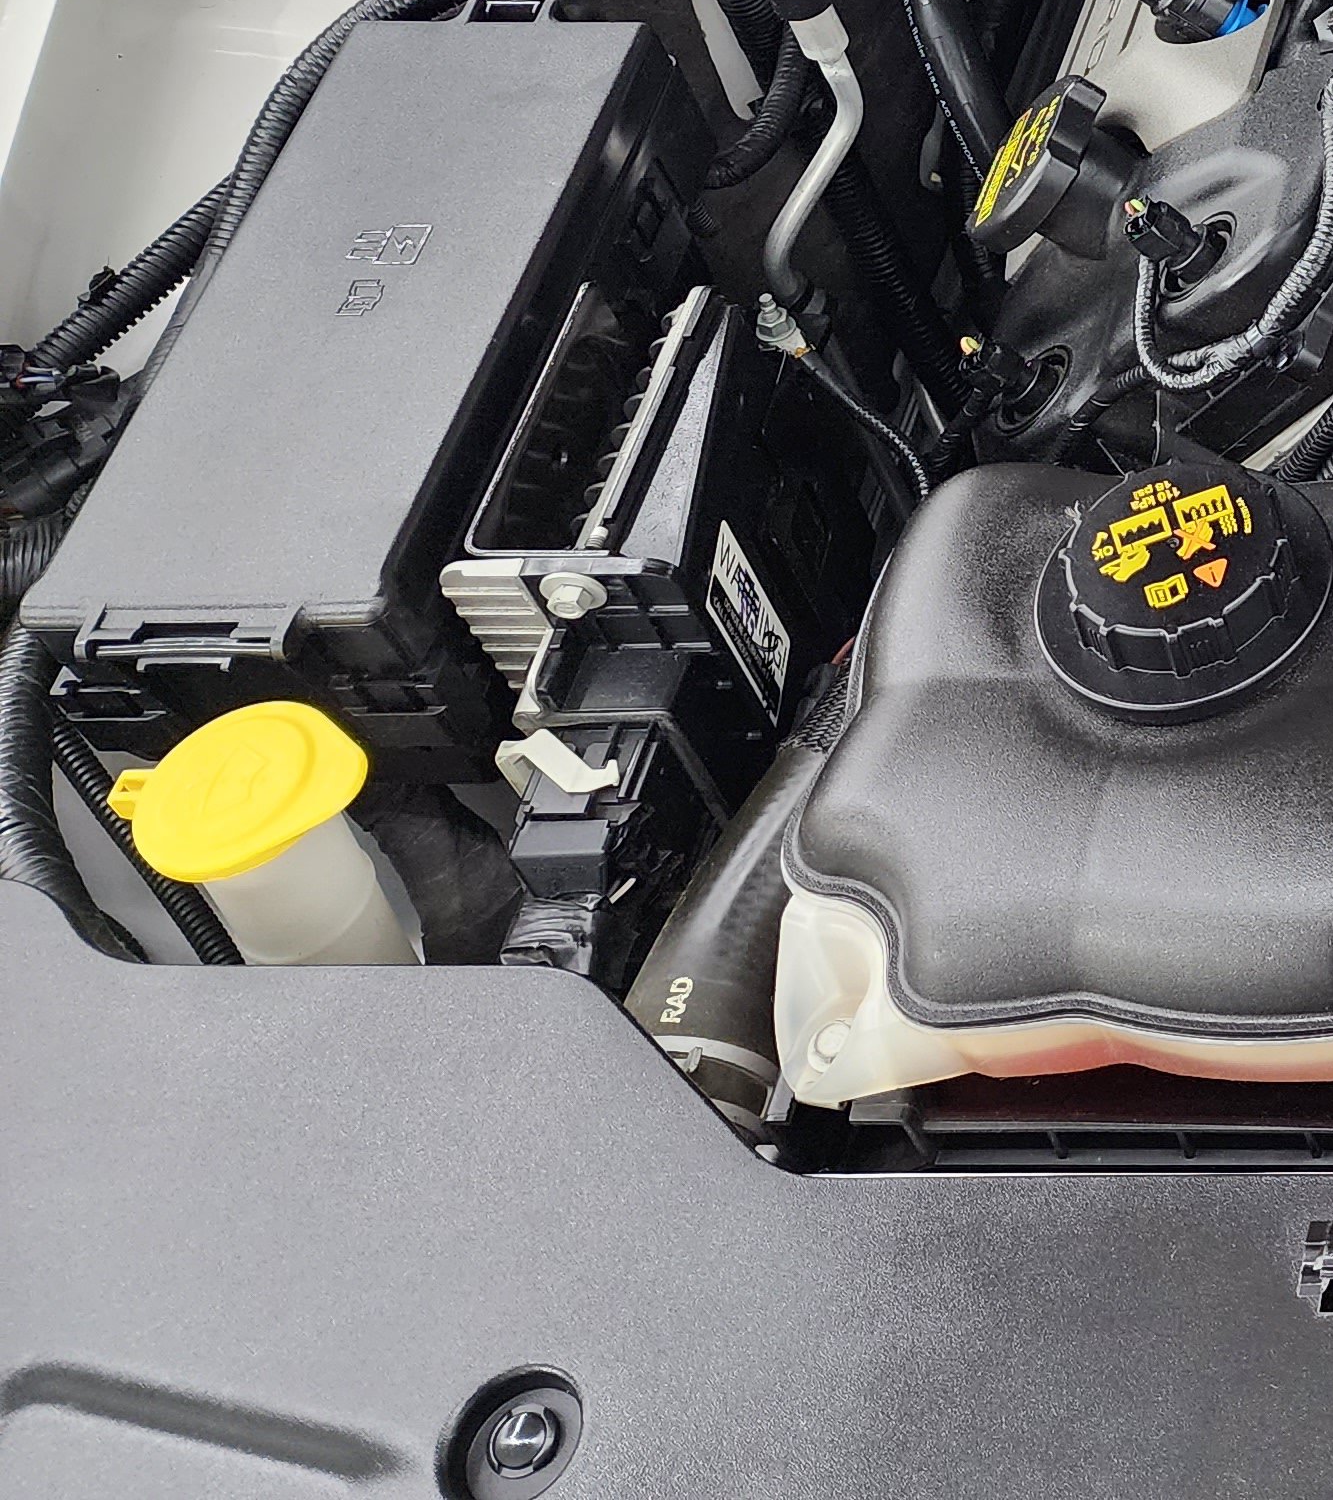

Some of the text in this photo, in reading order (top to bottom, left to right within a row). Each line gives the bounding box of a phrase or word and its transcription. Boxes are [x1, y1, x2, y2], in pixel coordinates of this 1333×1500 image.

[937, 98, 953, 119] A/C
[947, 119, 977, 165] SUCTION
[1130, 487, 1180, 511] 110 kPa
[1132, 484, 1153, 500] psi
[1092, 545, 1115, 561] OK
[660, 976, 694, 1024] RAD
